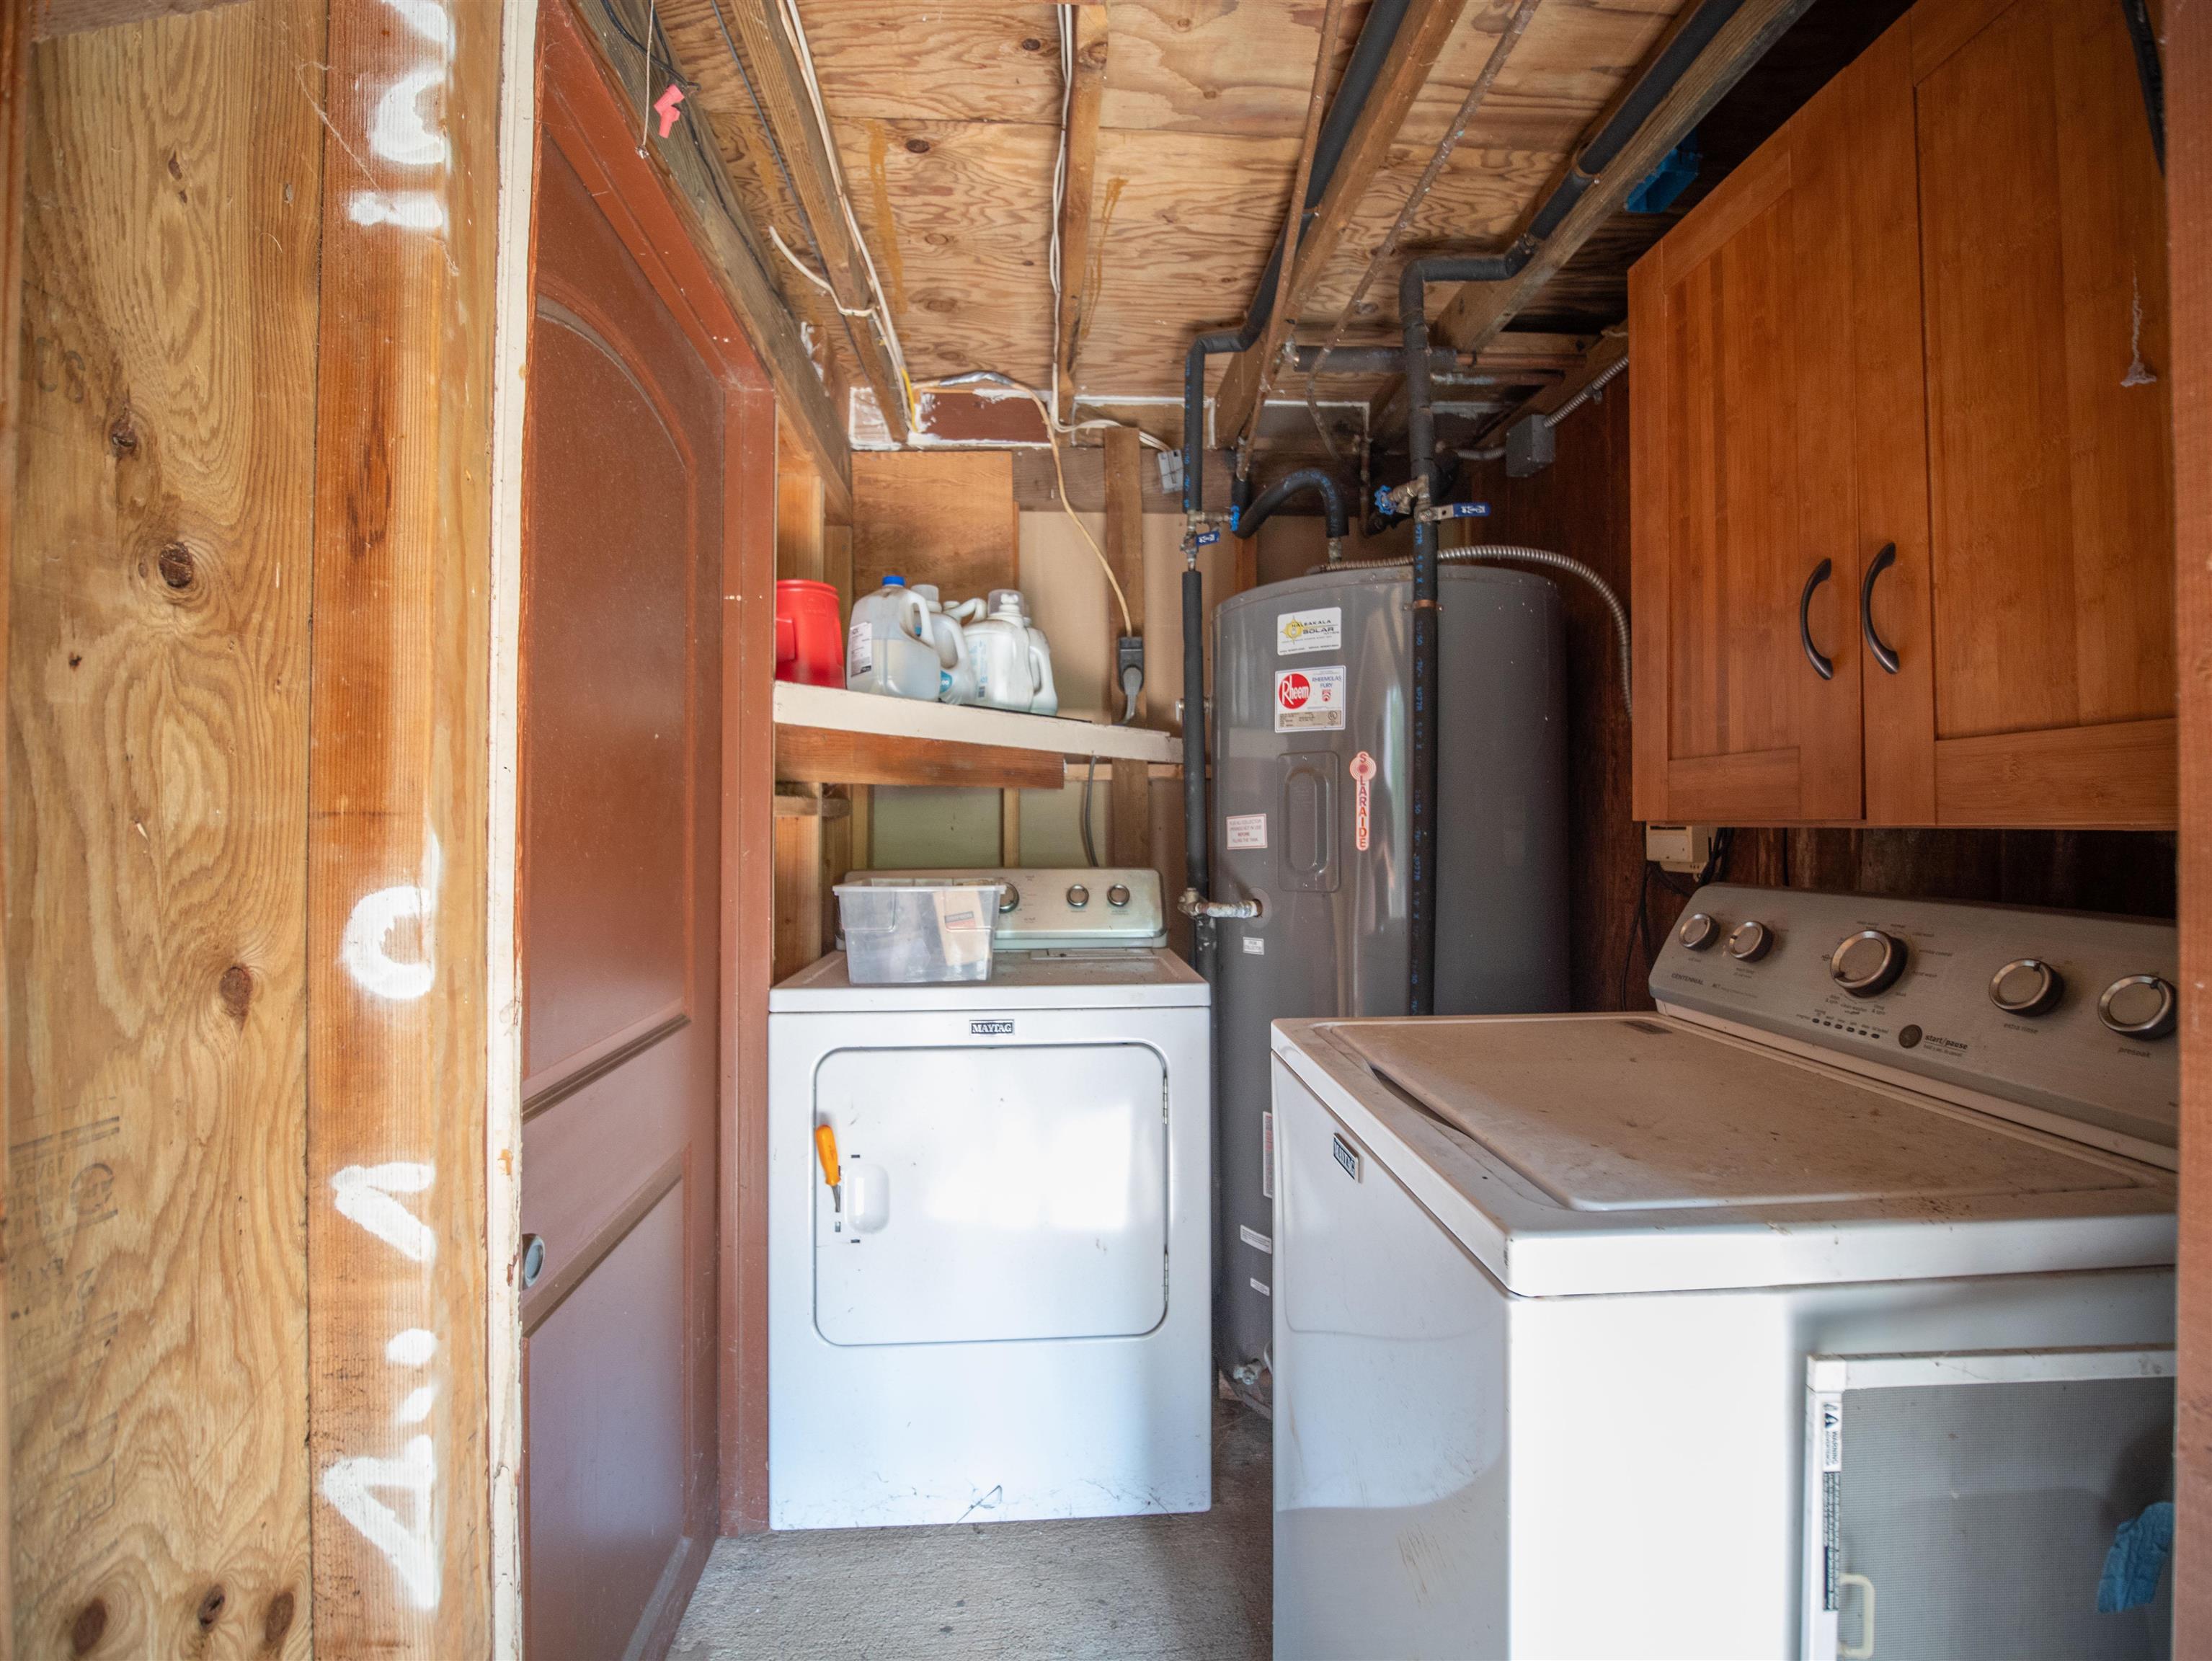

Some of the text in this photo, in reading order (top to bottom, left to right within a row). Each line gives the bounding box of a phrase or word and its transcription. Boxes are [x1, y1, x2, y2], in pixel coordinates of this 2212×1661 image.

[1282, 674, 1309, 706] Rheem
[1671, 973, 1703, 985] CENTENNIAL
[972, 1024, 1012, 1033] MAYTAG
[1925, 1035, 1968, 1050] start/pause
[2118, 1047, 2151, 1059] presoak
